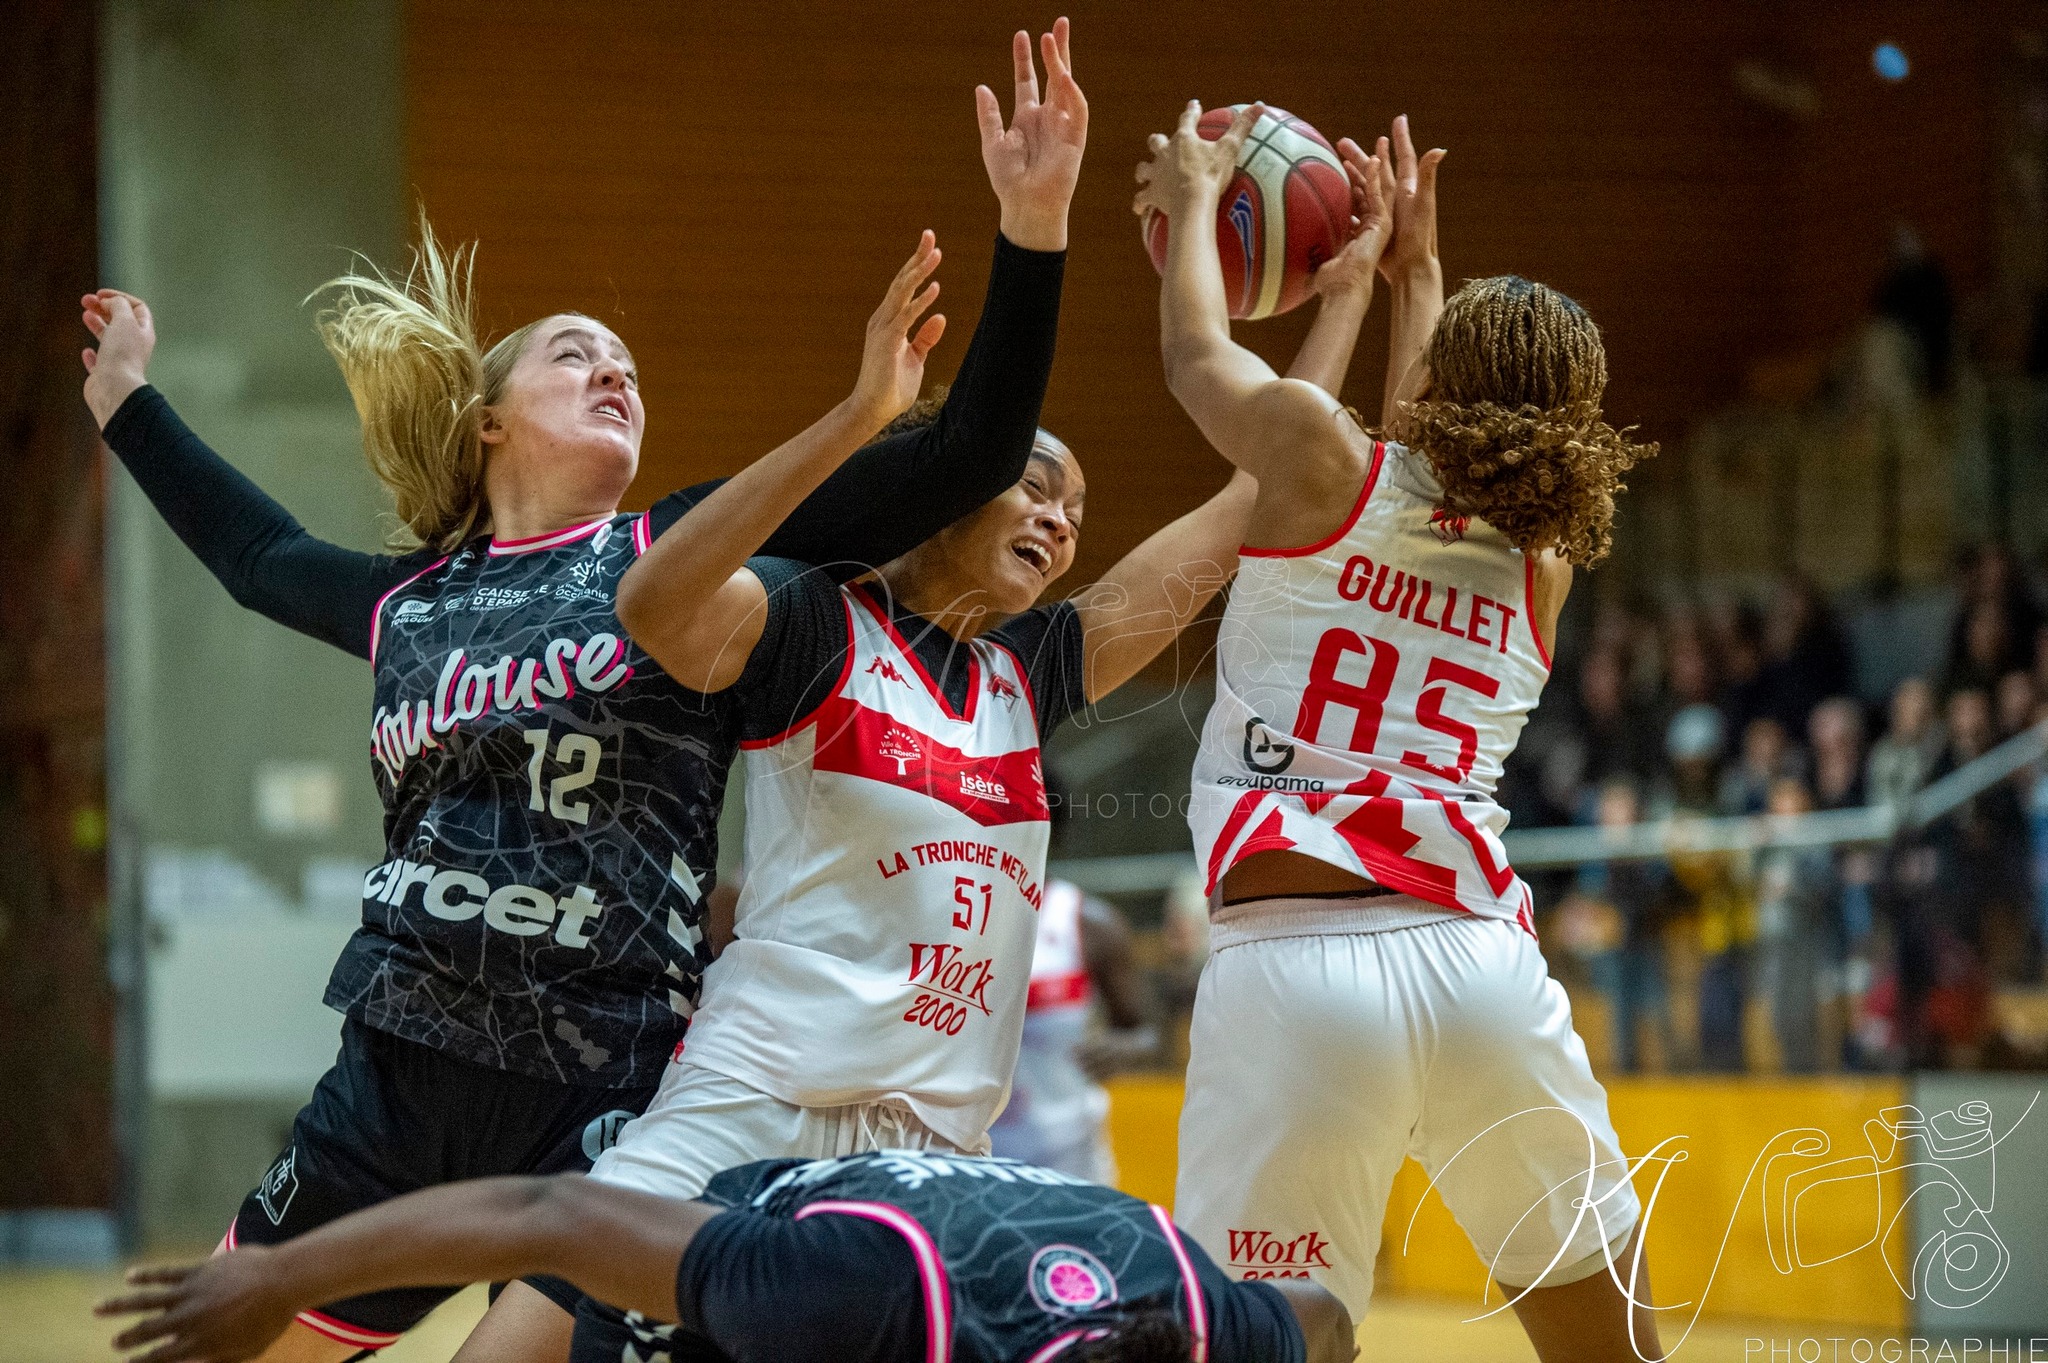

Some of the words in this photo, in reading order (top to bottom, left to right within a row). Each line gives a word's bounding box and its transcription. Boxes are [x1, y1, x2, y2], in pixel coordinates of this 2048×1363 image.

[478, 587, 530, 599] CAISSE
[1337, 555, 1517, 654] GUILLET
[371, 633, 634, 788] Toulouse
[1292, 627, 1501, 785] 85
[523, 728, 602, 825] 12
[889, 748, 922, 759] TRONCHE
[960, 771, 1006, 797] isère
[1216, 775, 1325, 794] Groupama
[362, 857, 603, 949] circet
[876, 851, 910, 880] LA
[911, 840, 998, 868] TRONCHE
[1000, 851, 1043, 912] MEYLAN
[952, 875, 993, 936] 51
[908, 942, 994, 1016] Work
[903, 993, 967, 1037] 2000
[1227, 1229, 1331, 1269] Work
